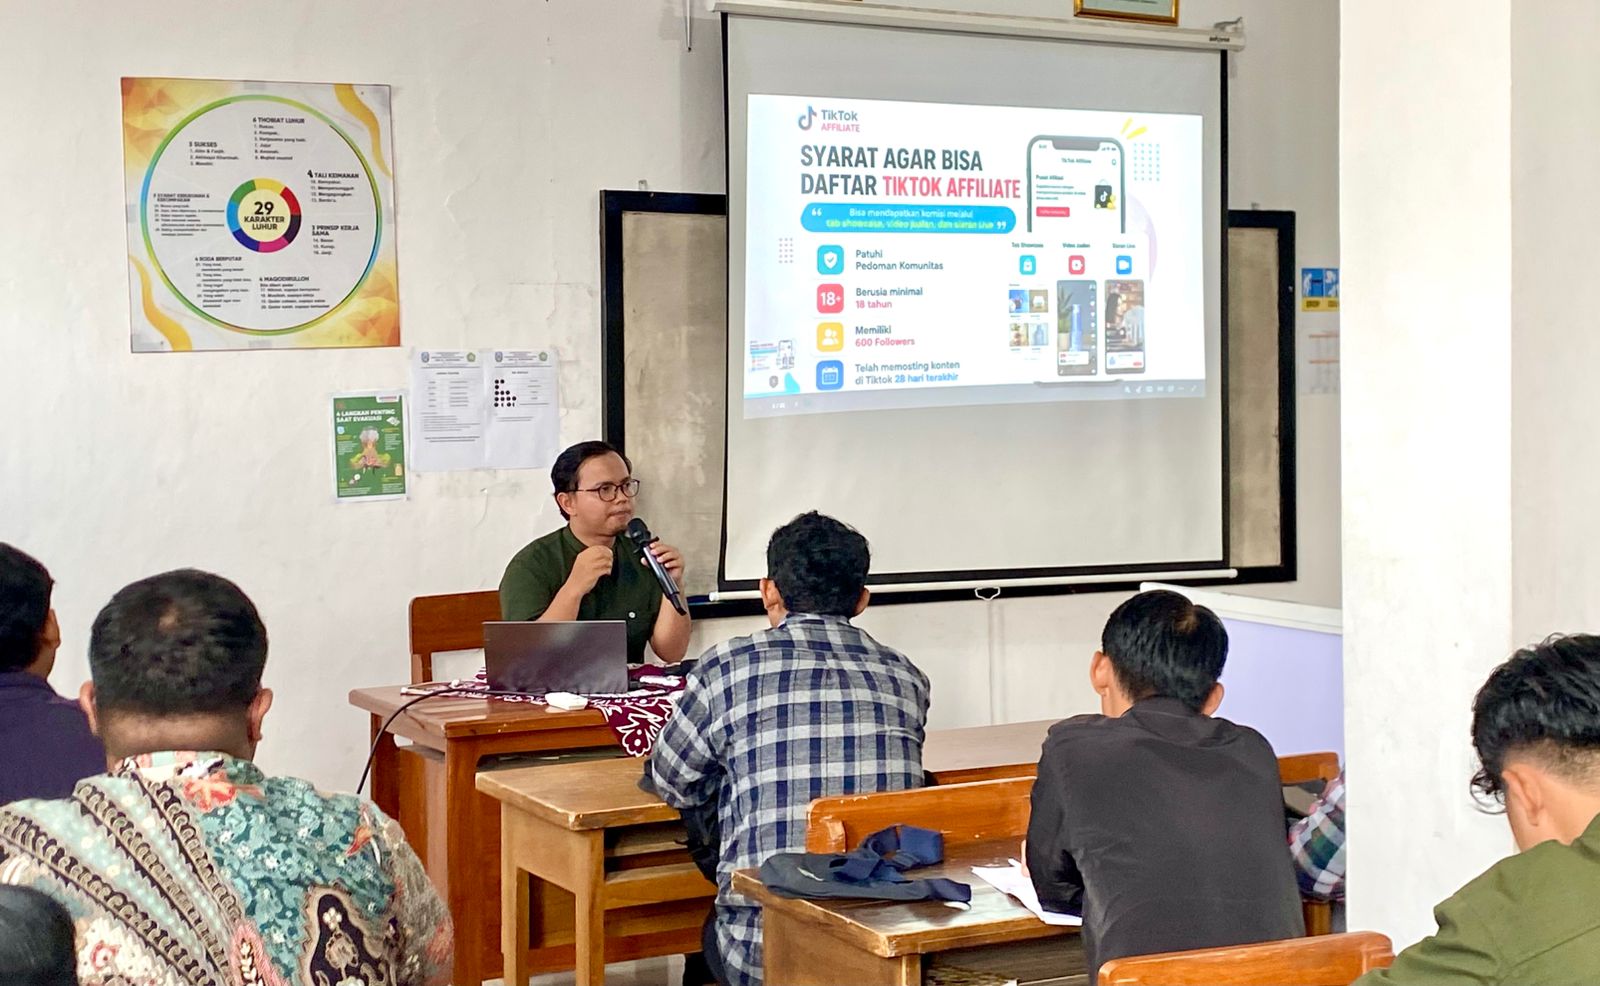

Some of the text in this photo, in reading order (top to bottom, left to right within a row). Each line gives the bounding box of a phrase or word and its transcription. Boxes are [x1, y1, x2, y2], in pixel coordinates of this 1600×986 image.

[821, 109, 858, 121] TikTok
[821, 123, 860, 132] AFFILIATE
[801, 144, 983, 171] SYARAT AGAR BISA
[801, 173, 1021, 198] DAFTAR TIKTOK AFFILIATE
[254, 201, 274, 215] 29
[849, 208, 973, 218] Bisa mendapatkan komisi melalui
[826, 219, 840, 228] tab
[938, 220, 952, 229] dan
[856, 250, 883, 258] Patuhi
[856, 261, 943, 270] Pedoman Komunitas
[856, 287, 923, 296] Berusia minimal
[820, 291, 841, 306] 18+
[856, 300, 892, 309] 18 tahun
[855, 325, 892, 335] Memiliki
[855, 338, 915, 347] 600 Followers
[855, 361, 960, 372] Telah memosting konten
[855, 372, 958, 385] di Tiktok 28 hari terakhir
